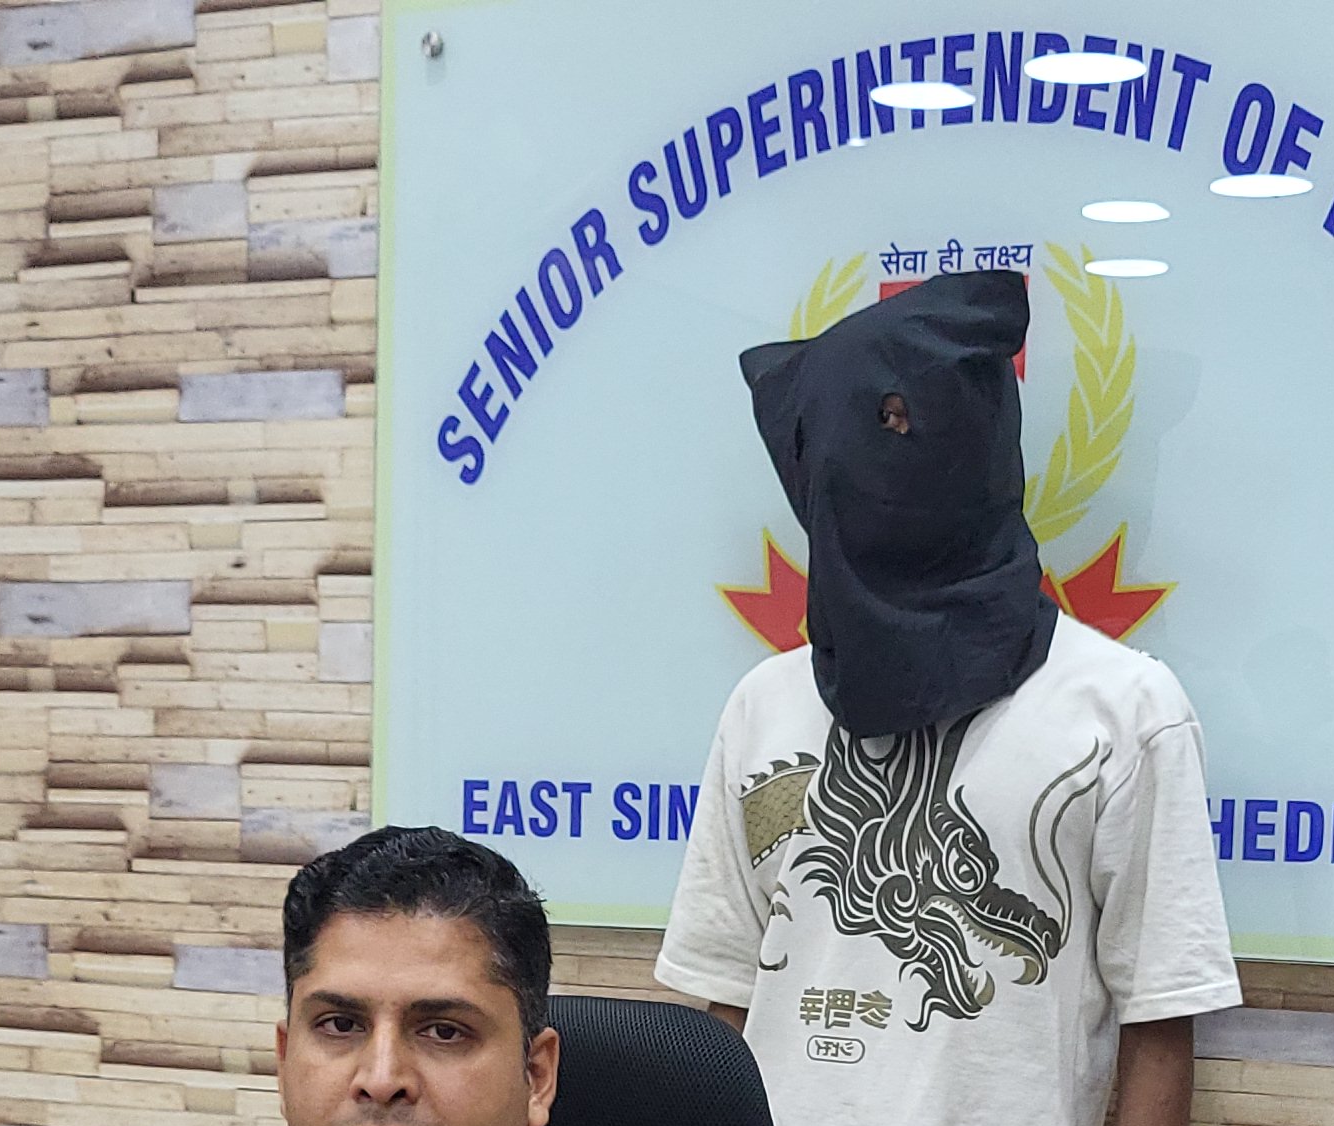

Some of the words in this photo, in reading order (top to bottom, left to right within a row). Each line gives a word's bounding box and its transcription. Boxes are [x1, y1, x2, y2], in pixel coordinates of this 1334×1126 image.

[437, 208, 623, 484] SENIOR
[628, 31, 1212, 245] SUPERINTENDENT
[1222, 82, 1324, 180] OF
[879, 242, 927, 275] सेवा
[937, 239, 964, 274] ही
[973, 245, 1034, 271] लक्ष्य
[463, 780, 592, 838] EAST
